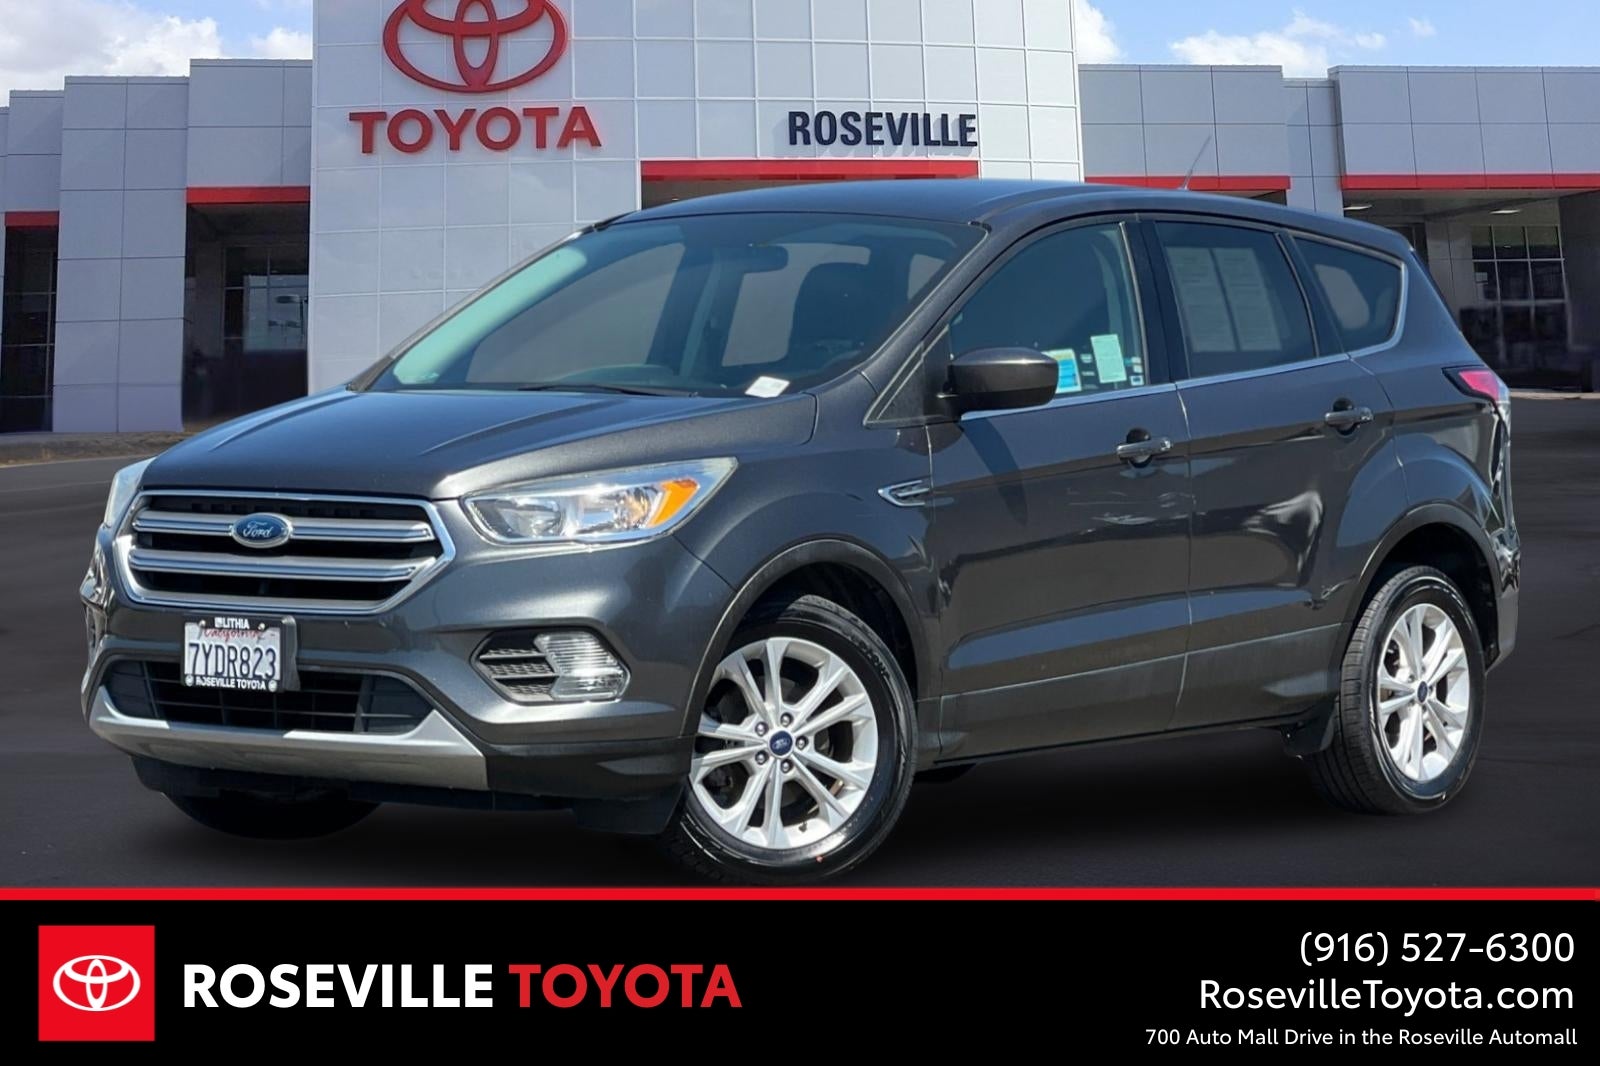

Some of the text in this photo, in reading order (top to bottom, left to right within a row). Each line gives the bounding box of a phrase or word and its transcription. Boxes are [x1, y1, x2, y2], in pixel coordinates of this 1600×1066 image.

[349, 106, 602, 154] TOYOTA
[788, 111, 978, 147] ROSEVILLE
[242, 520, 274, 538] Ford
[223, 617, 250, 630] LITHIA
[188, 642, 277, 680] 7YDR823
[195, 676, 267, 691] ROSEVILLE TOYOTA
